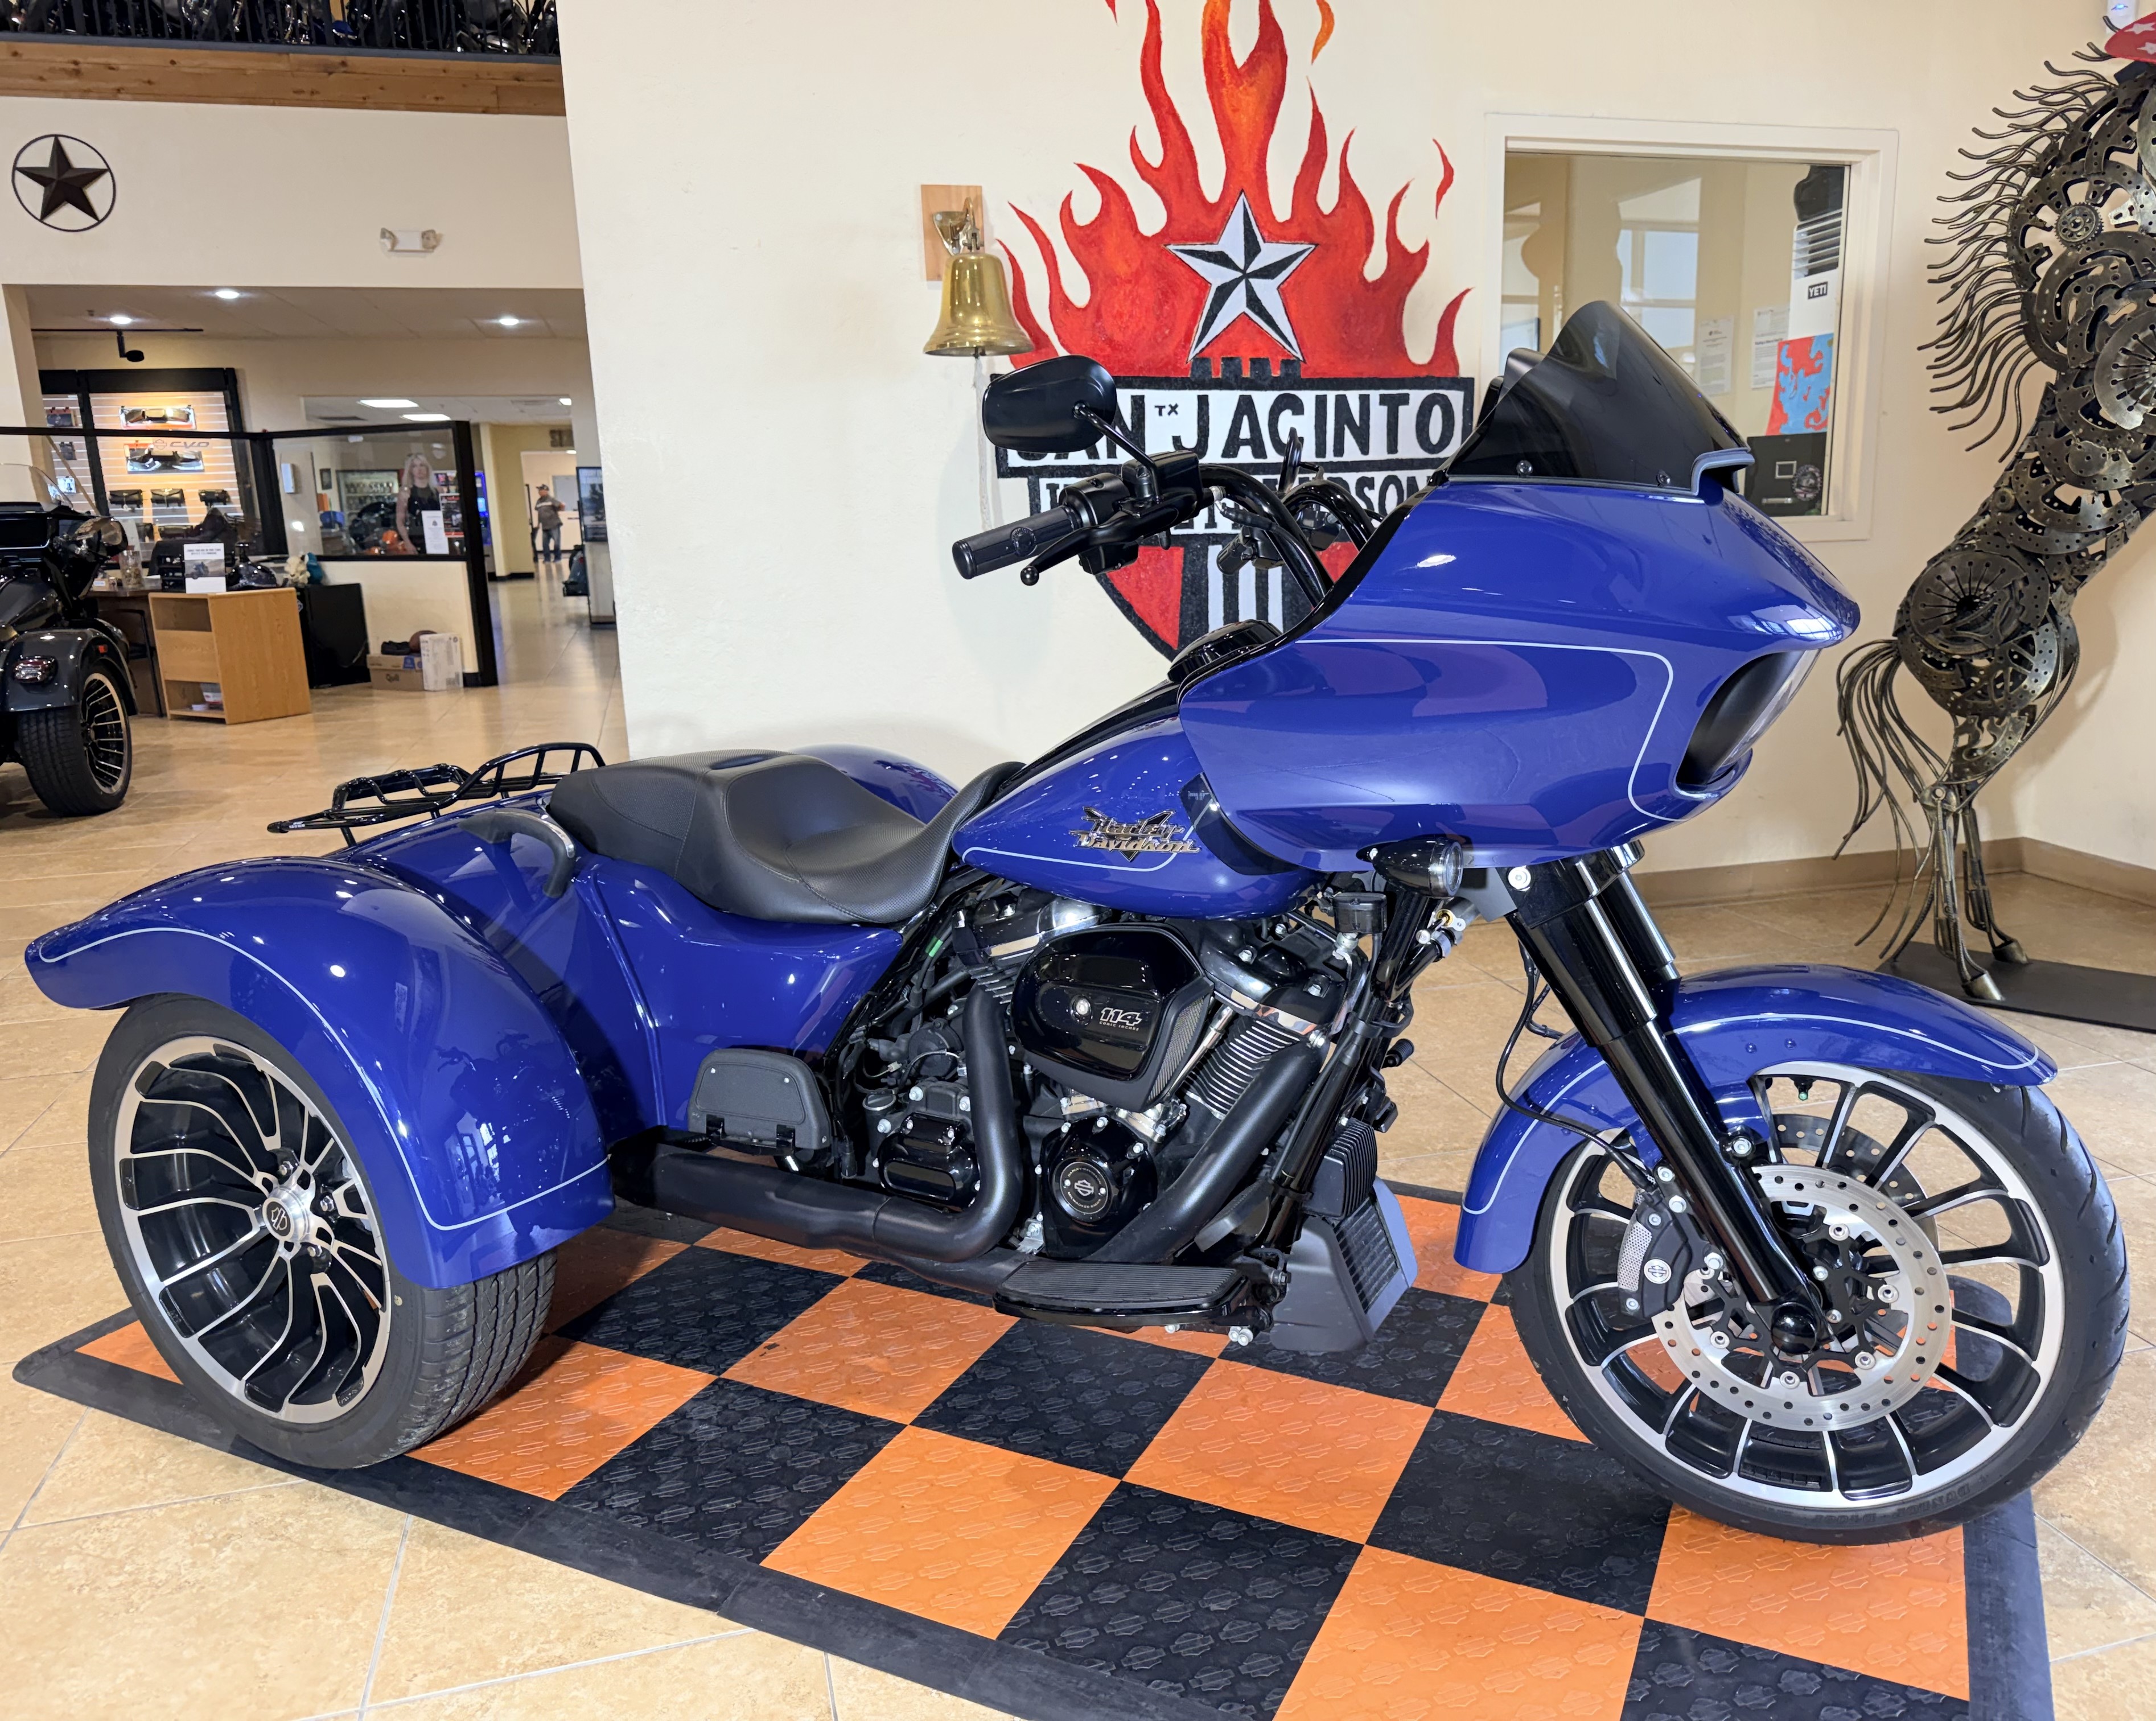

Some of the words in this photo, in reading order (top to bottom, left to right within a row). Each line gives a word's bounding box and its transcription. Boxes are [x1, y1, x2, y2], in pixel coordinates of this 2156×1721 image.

[1809, 284, 1826, 297] YETI
[1155, 404, 1179, 417] TX
[1172, 393, 1455, 460] JACINTO
[1100, 1007, 1142, 1026] 114
